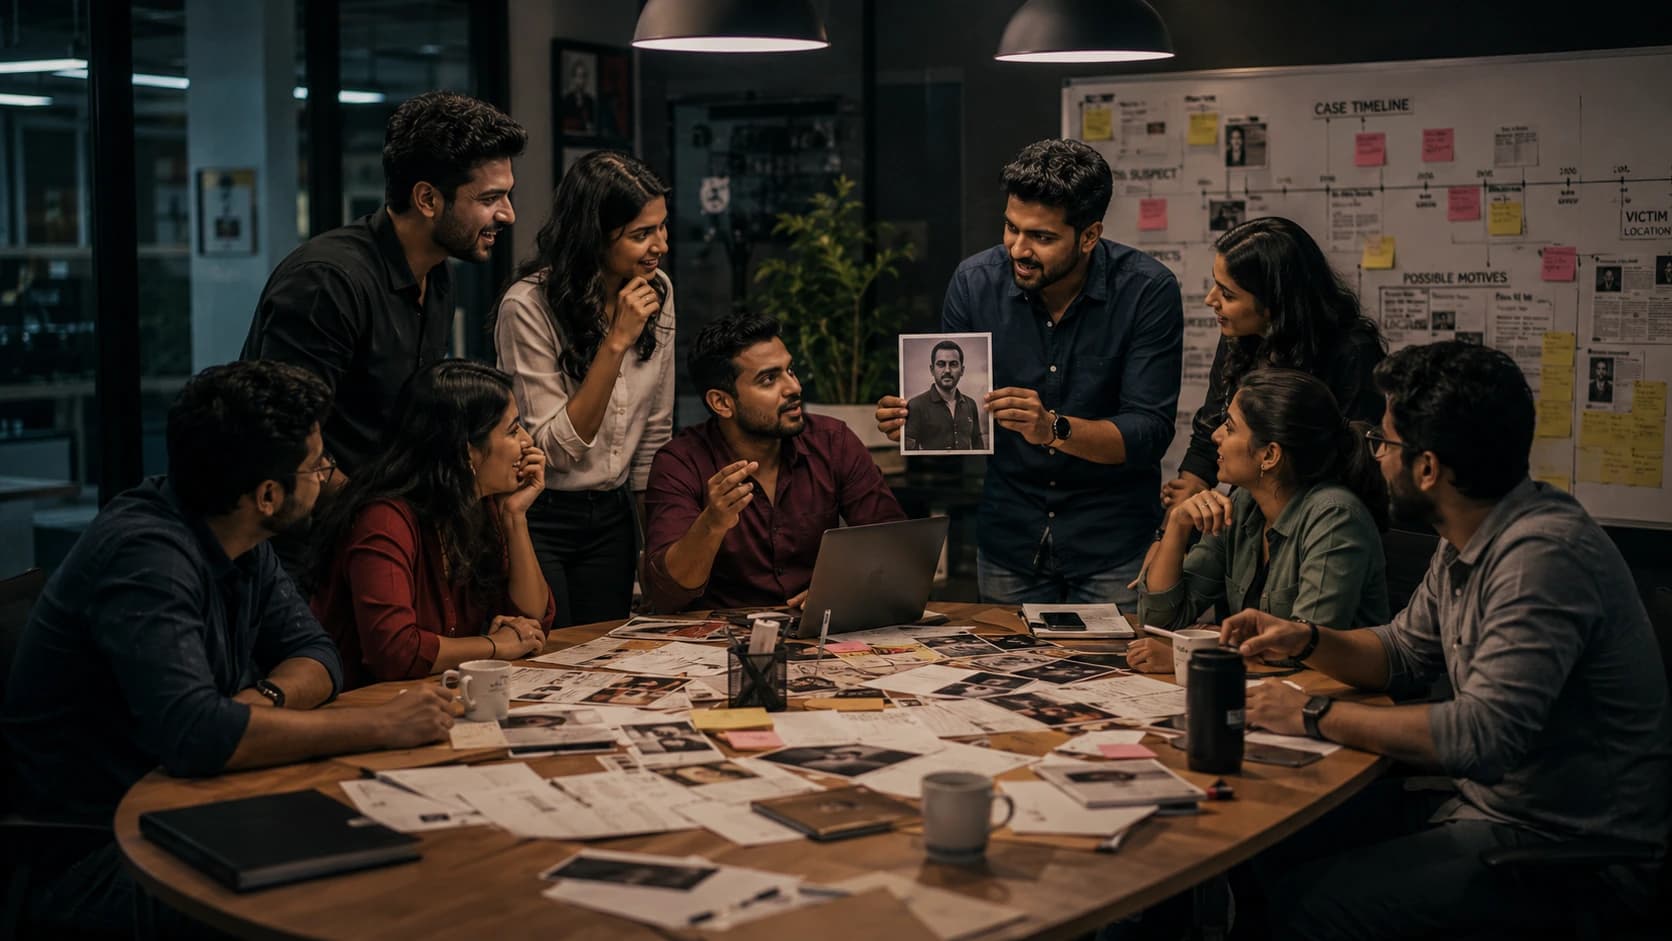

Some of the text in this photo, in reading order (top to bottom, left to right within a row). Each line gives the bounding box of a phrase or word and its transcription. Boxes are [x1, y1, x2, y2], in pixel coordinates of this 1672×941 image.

[1315, 98, 1409, 115] CASE TIMELINE
[1130, 168, 1177, 181] SUSPECT
[1626, 210, 1668, 223] VICTIM
[1624, 227, 1672, 236] LOCATION
[1403, 271, 1508, 284] POSSIBLE MOTIVES
